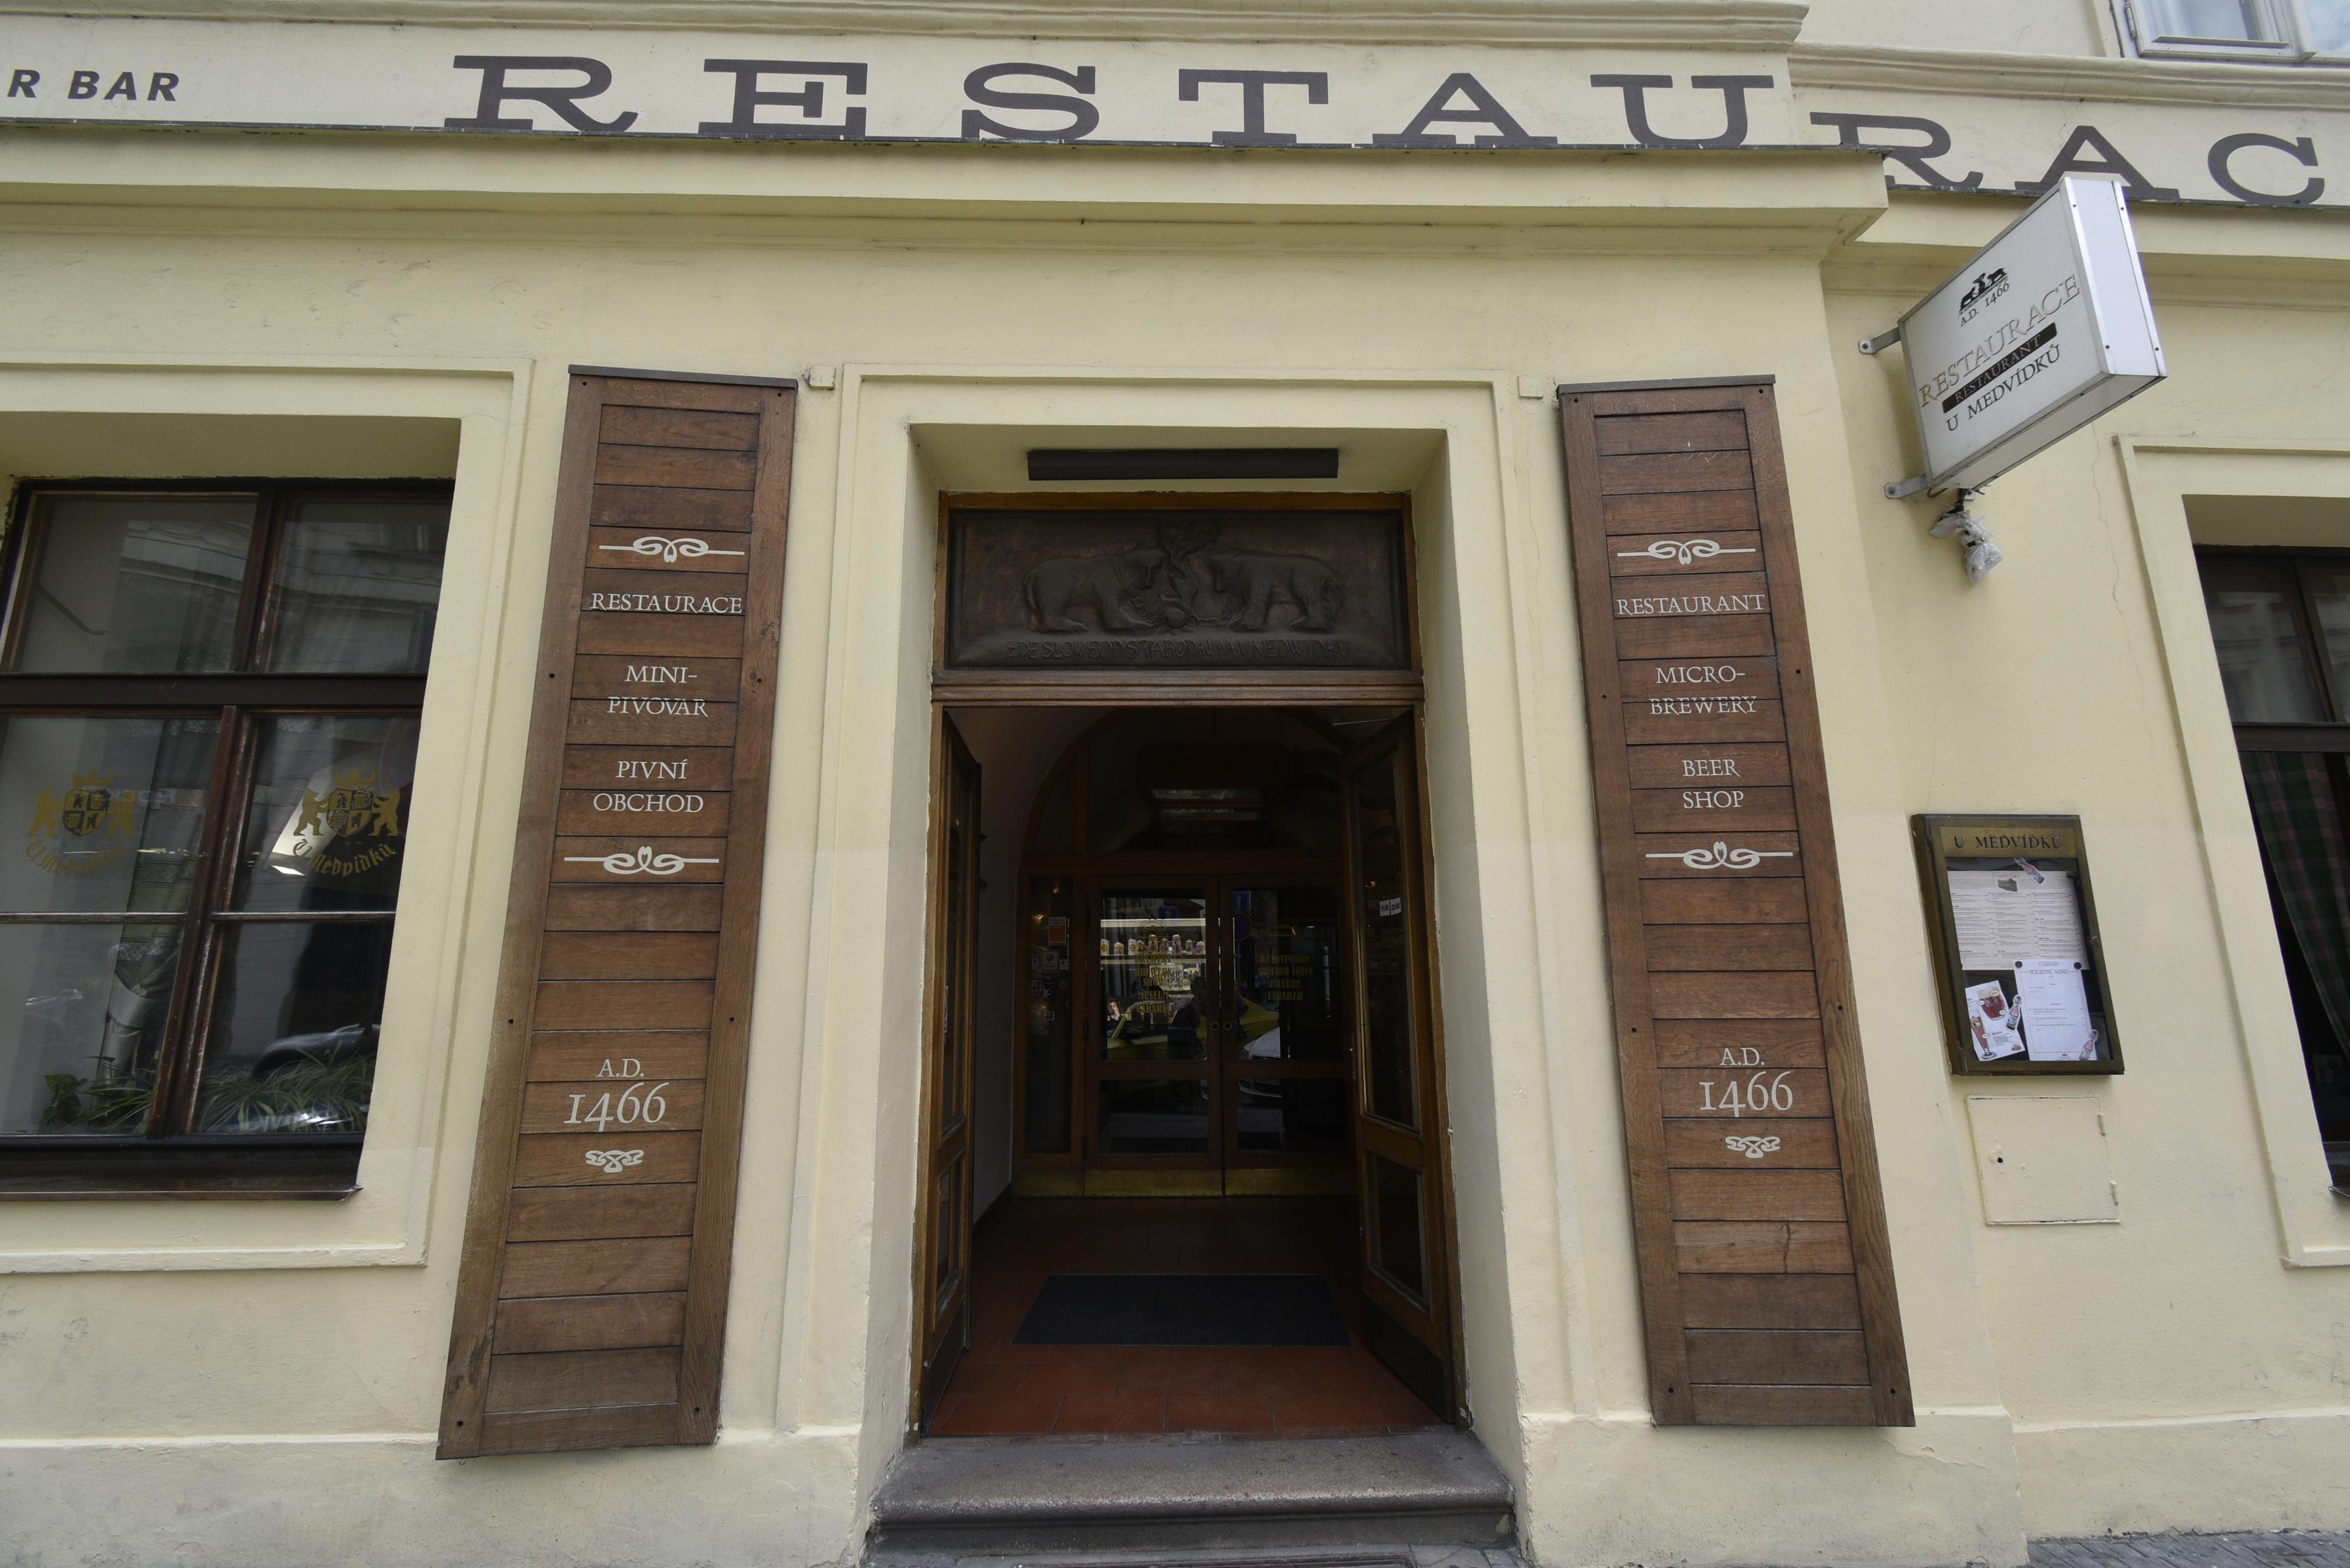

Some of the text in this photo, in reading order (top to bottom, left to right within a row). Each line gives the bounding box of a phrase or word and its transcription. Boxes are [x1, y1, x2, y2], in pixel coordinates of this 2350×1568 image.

[67, 70, 179, 102] BAR
[1960, 308, 1979, 327] A.D.
[1985, 278, 2009, 307] 1466
[1918, 274, 2080, 408] RESTAURACE
[1955, 334, 2041, 404] RESTAURANT
[1946, 344, 2060, 432] U MEDVÍDKŮ
[589, 592, 743, 615] RESTAURACE
[1616, 594, 1765, 616] RESTAURANT
[624, 665, 698, 684] MINI-
[1655, 665, 1745, 684] MICRO-
[606, 696, 709, 717] PIVOVAR
[1648, 695, 1757, 716] BREWERY
[615, 758, 689, 780] PIVNÍ
[1681, 758, 1741, 777] BEER
[593, 793, 704, 813] OBCHOD
[1683, 790, 1744, 809] SHOP
[1953, 832, 2063, 850] U MEDVÍDKŮ
[1719, 1047, 1765, 1066] A.D.
[596, 1058, 644, 1077] A.D.
[1698, 1071, 1794, 1117] 1466
[563, 1082, 670, 1133] 1466
